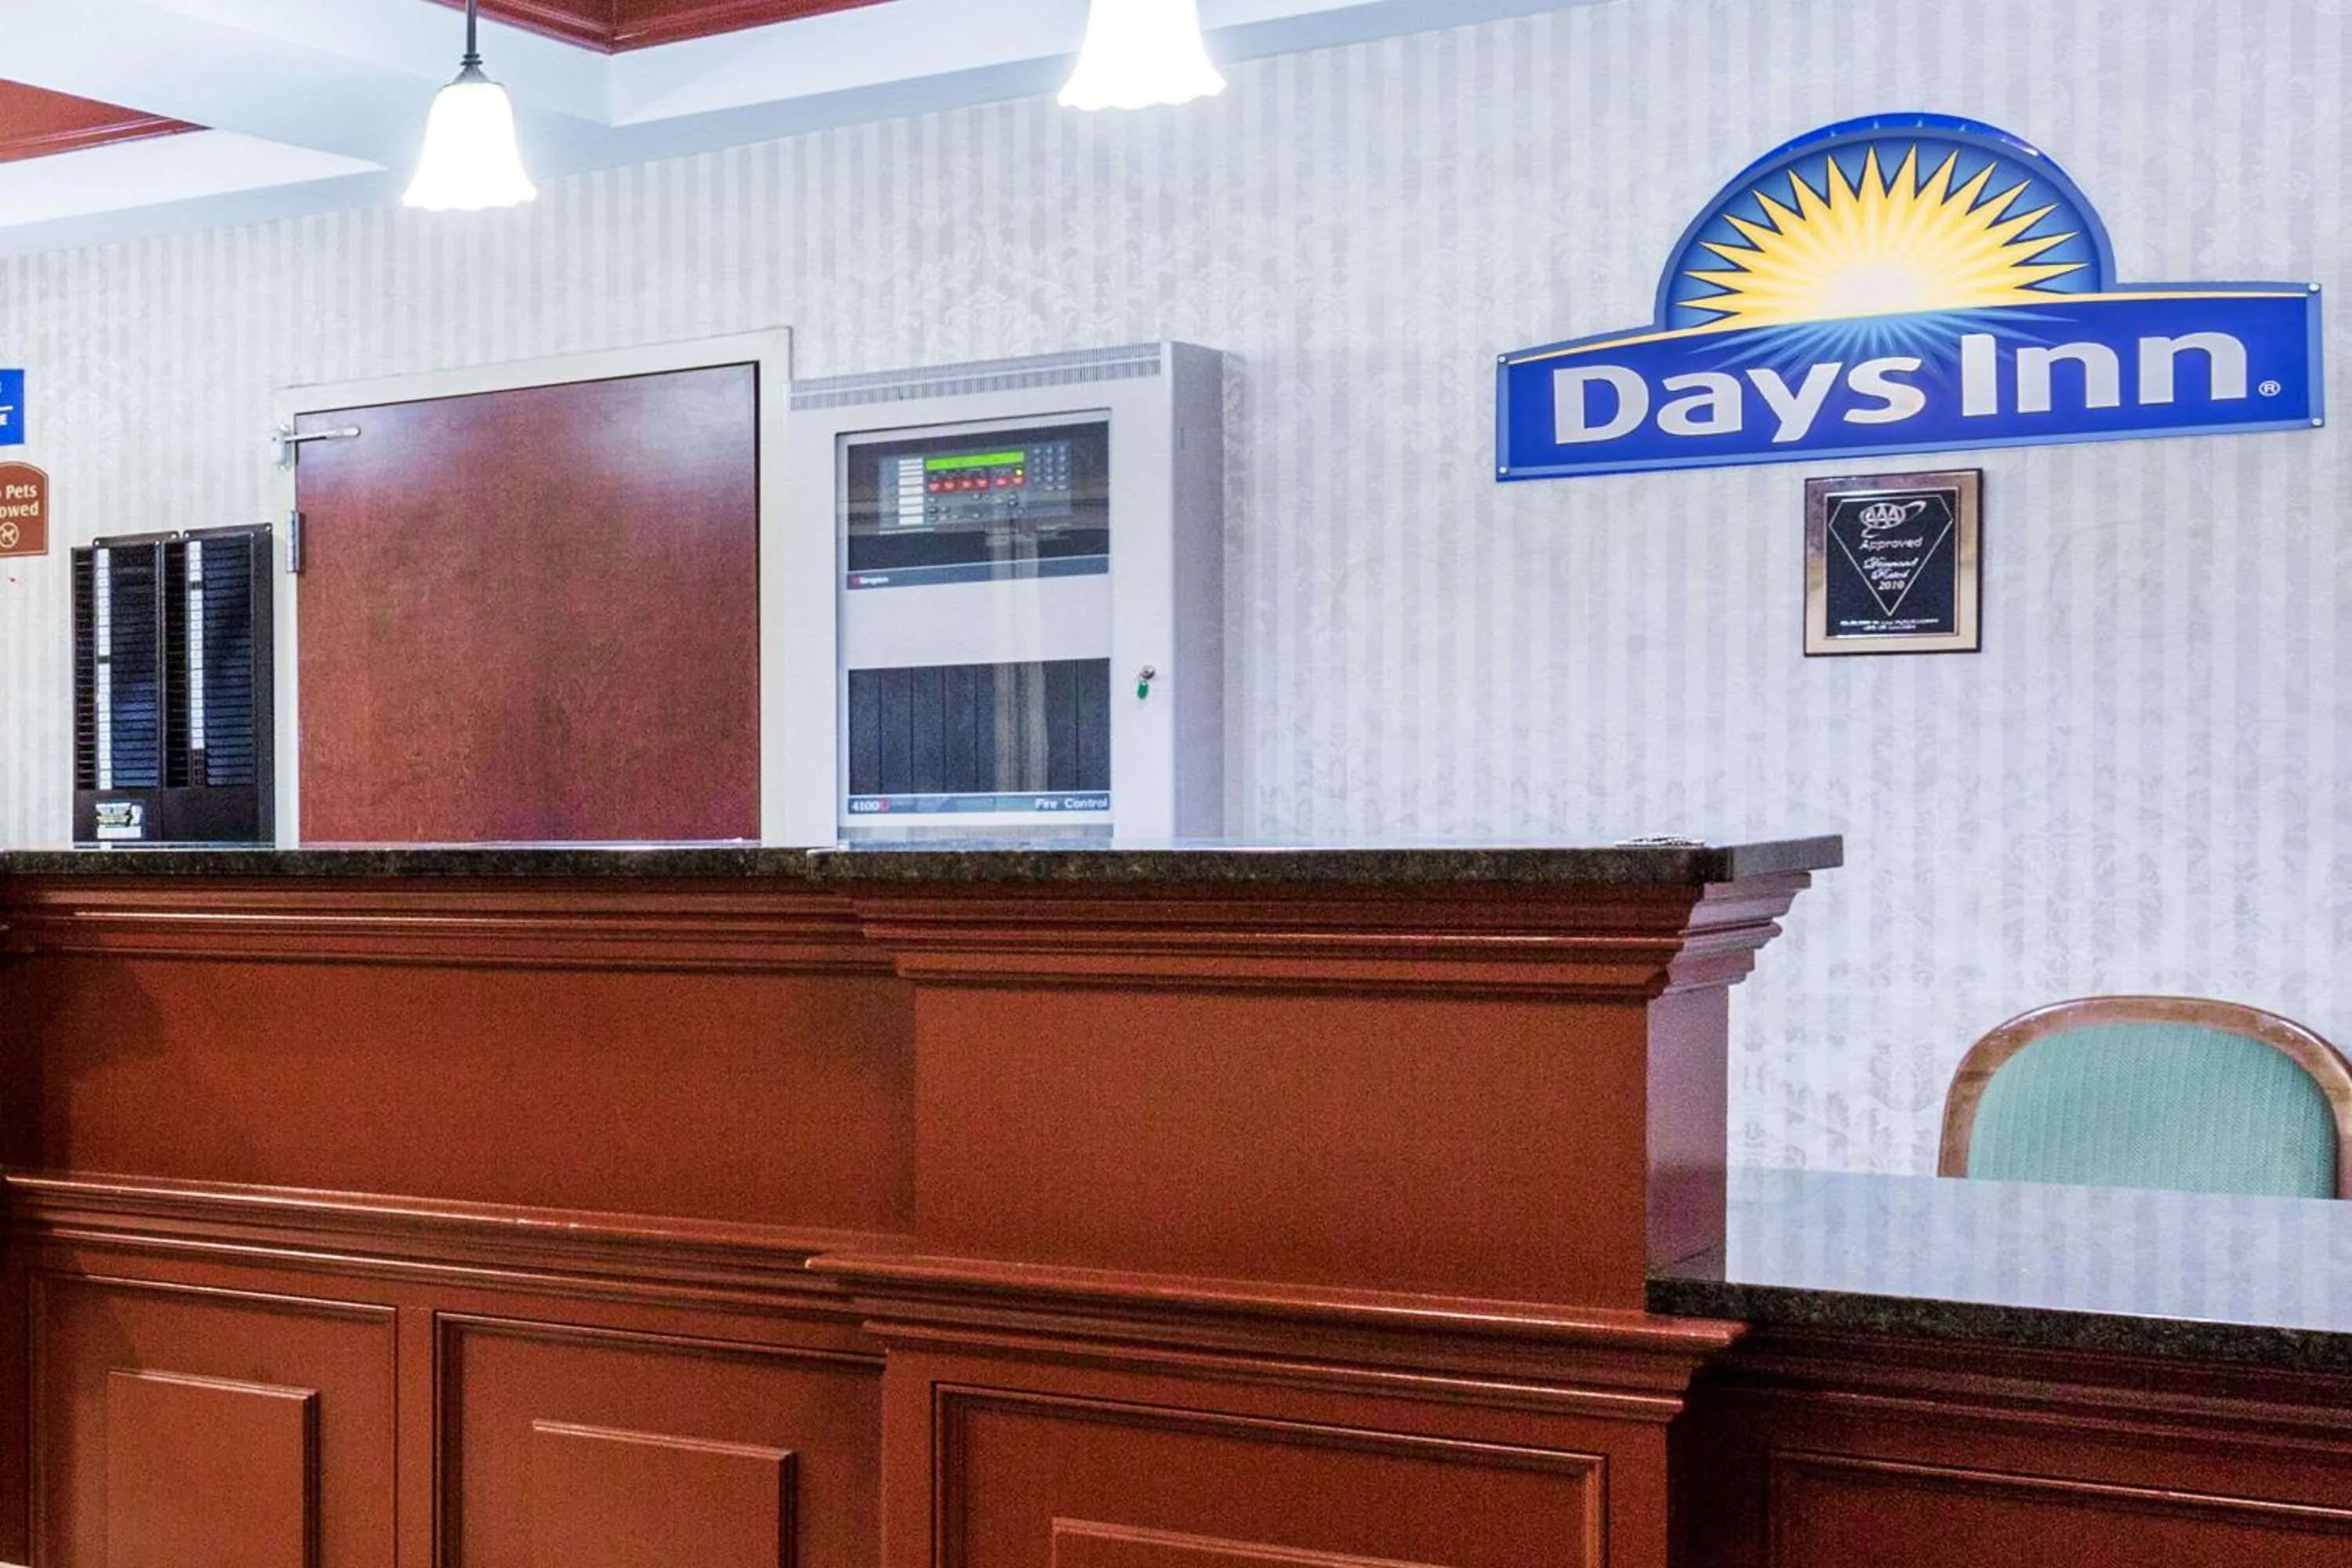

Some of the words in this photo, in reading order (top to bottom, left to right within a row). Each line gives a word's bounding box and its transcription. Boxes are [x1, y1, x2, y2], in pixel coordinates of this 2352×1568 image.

[1552, 356, 1926, 445] Days
[1960, 333, 2248, 418] Inn
[5, 485, 37, 499] Pets
[1859, 537, 1923, 551] Approved
[1035, 799, 1058, 809] Fire
[1065, 797, 1108, 808] Control
